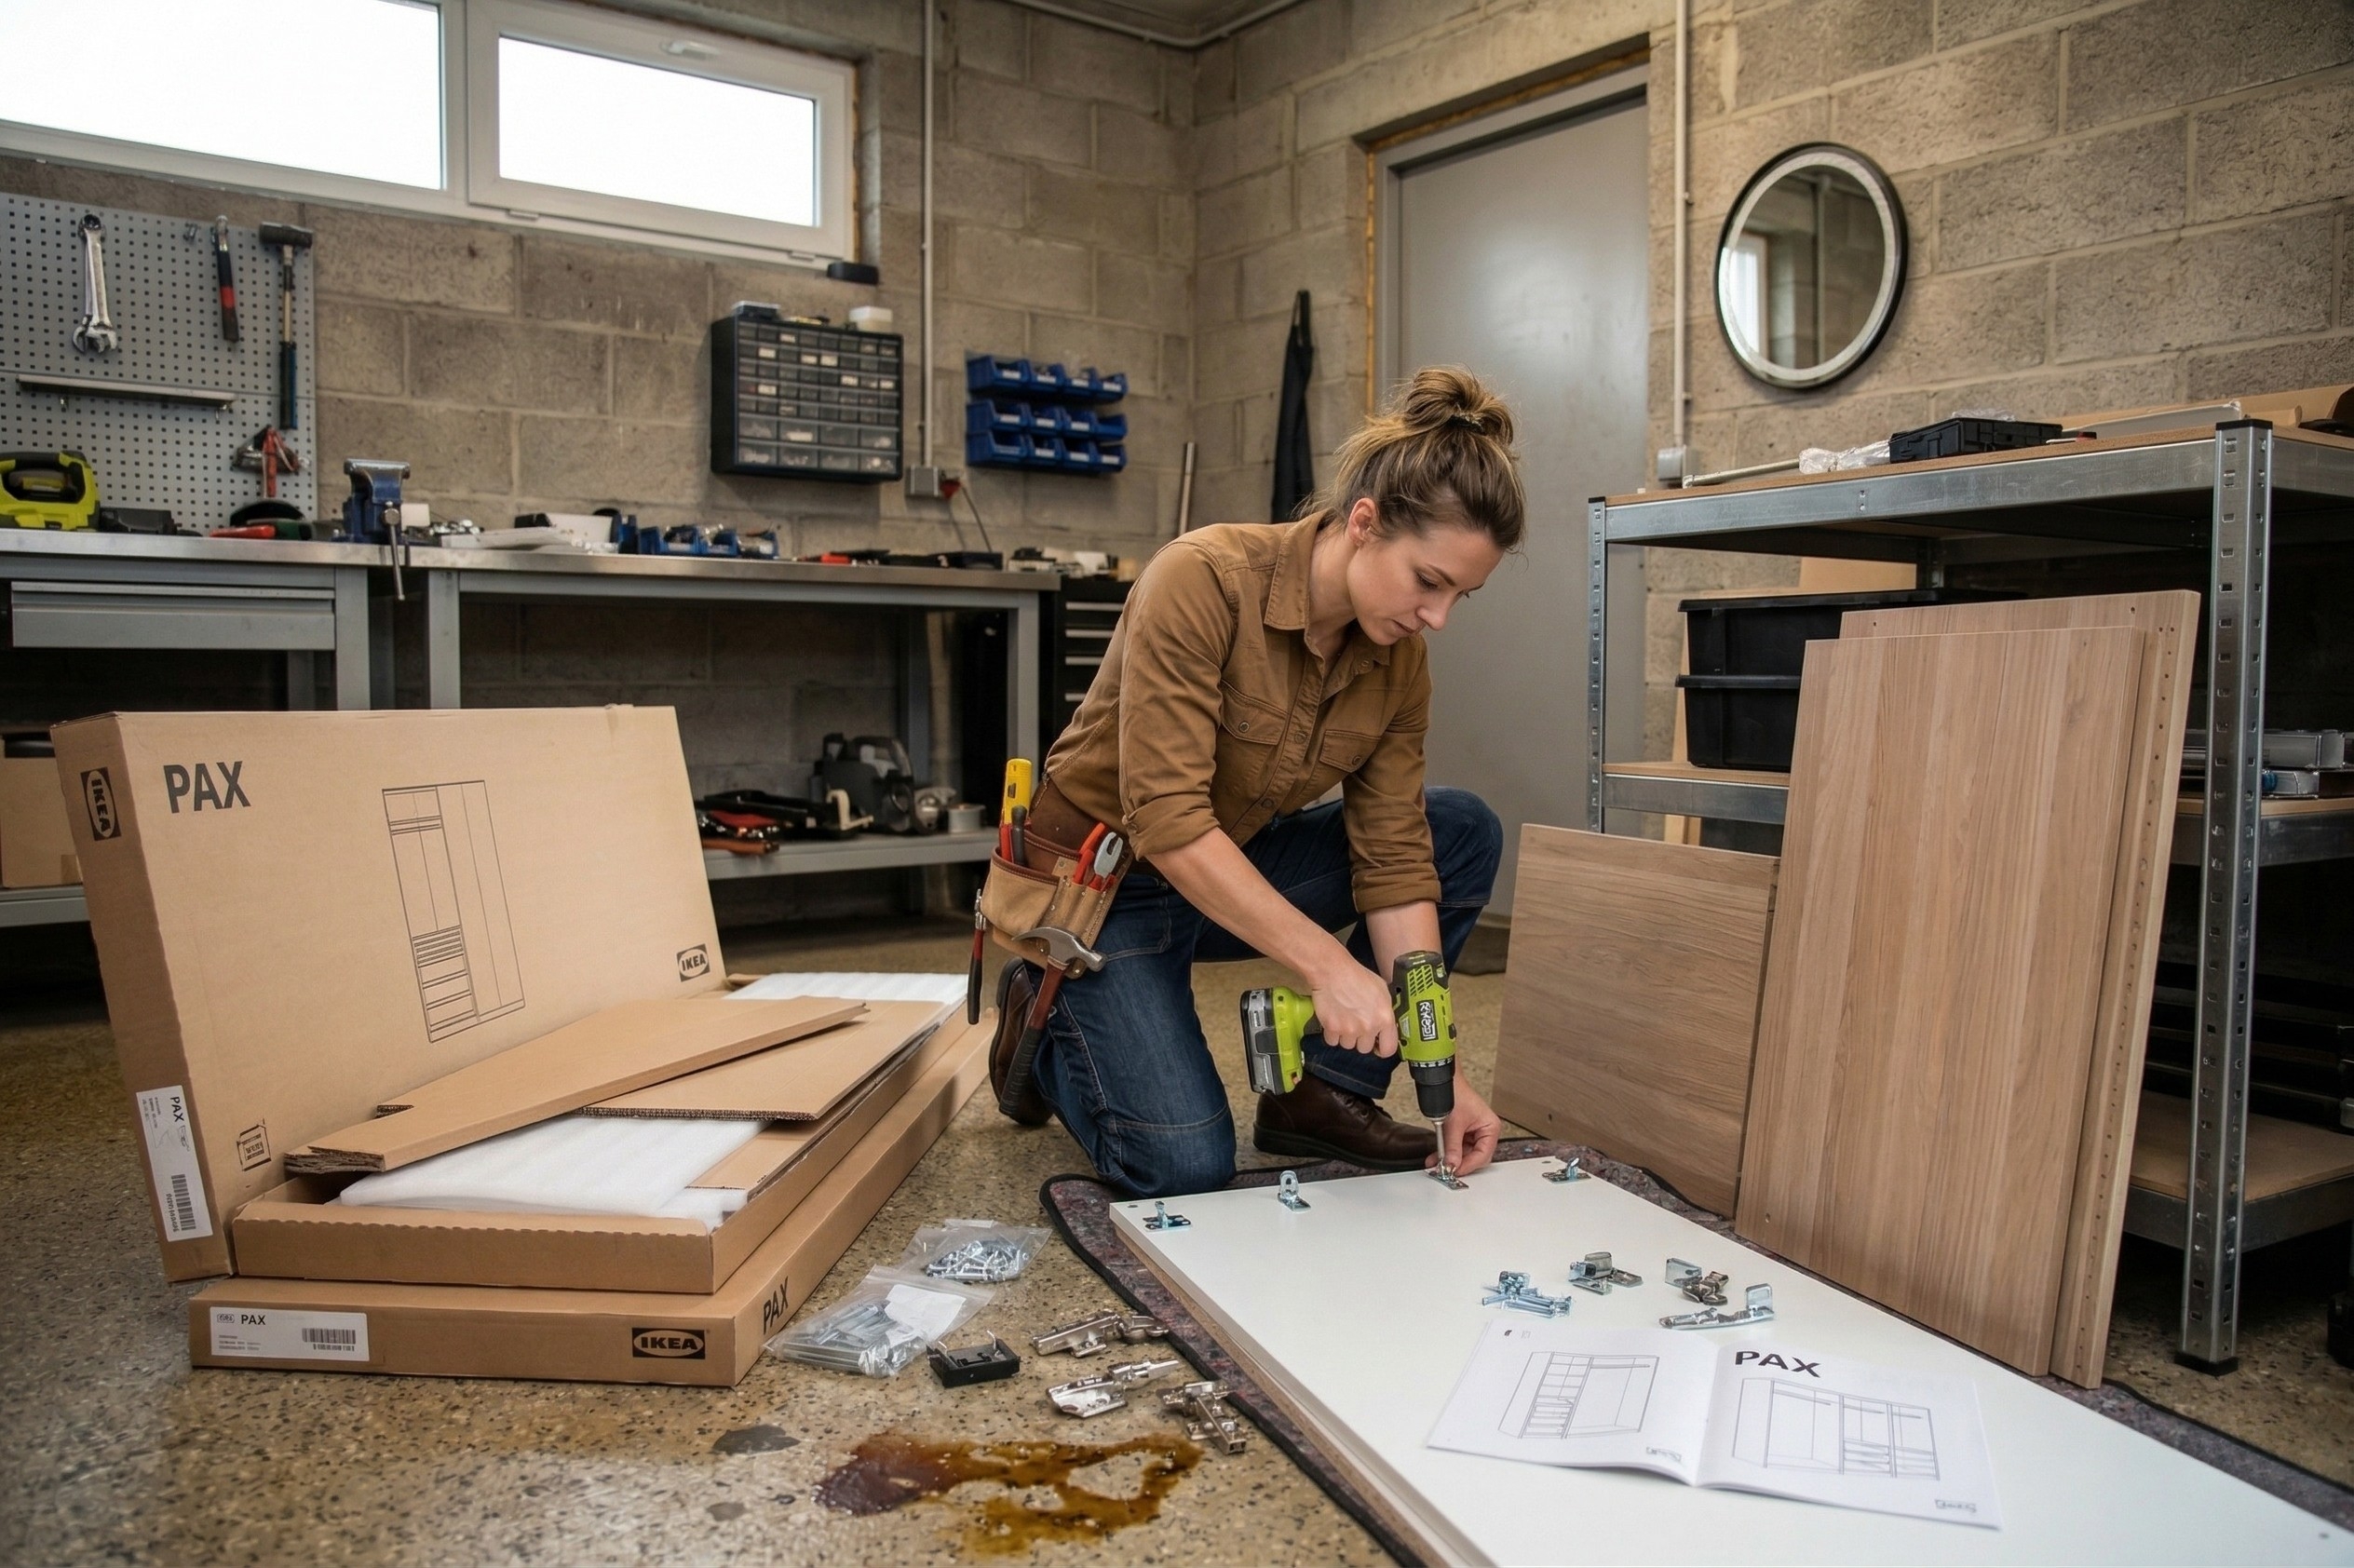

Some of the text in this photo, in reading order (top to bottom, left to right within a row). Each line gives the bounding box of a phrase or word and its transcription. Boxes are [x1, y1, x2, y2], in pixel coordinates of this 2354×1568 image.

[163, 761, 251, 814] PAX
[91, 778, 112, 832] IKEA
[682, 953, 707, 971] IKEA
[169, 1096, 184, 1123] PAX
[763, 1276, 789, 1335] PAX
[240, 1314, 266, 1325] PAX
[641, 1336, 698, 1350] IKEA
[1735, 1351, 1820, 1378] PAX
